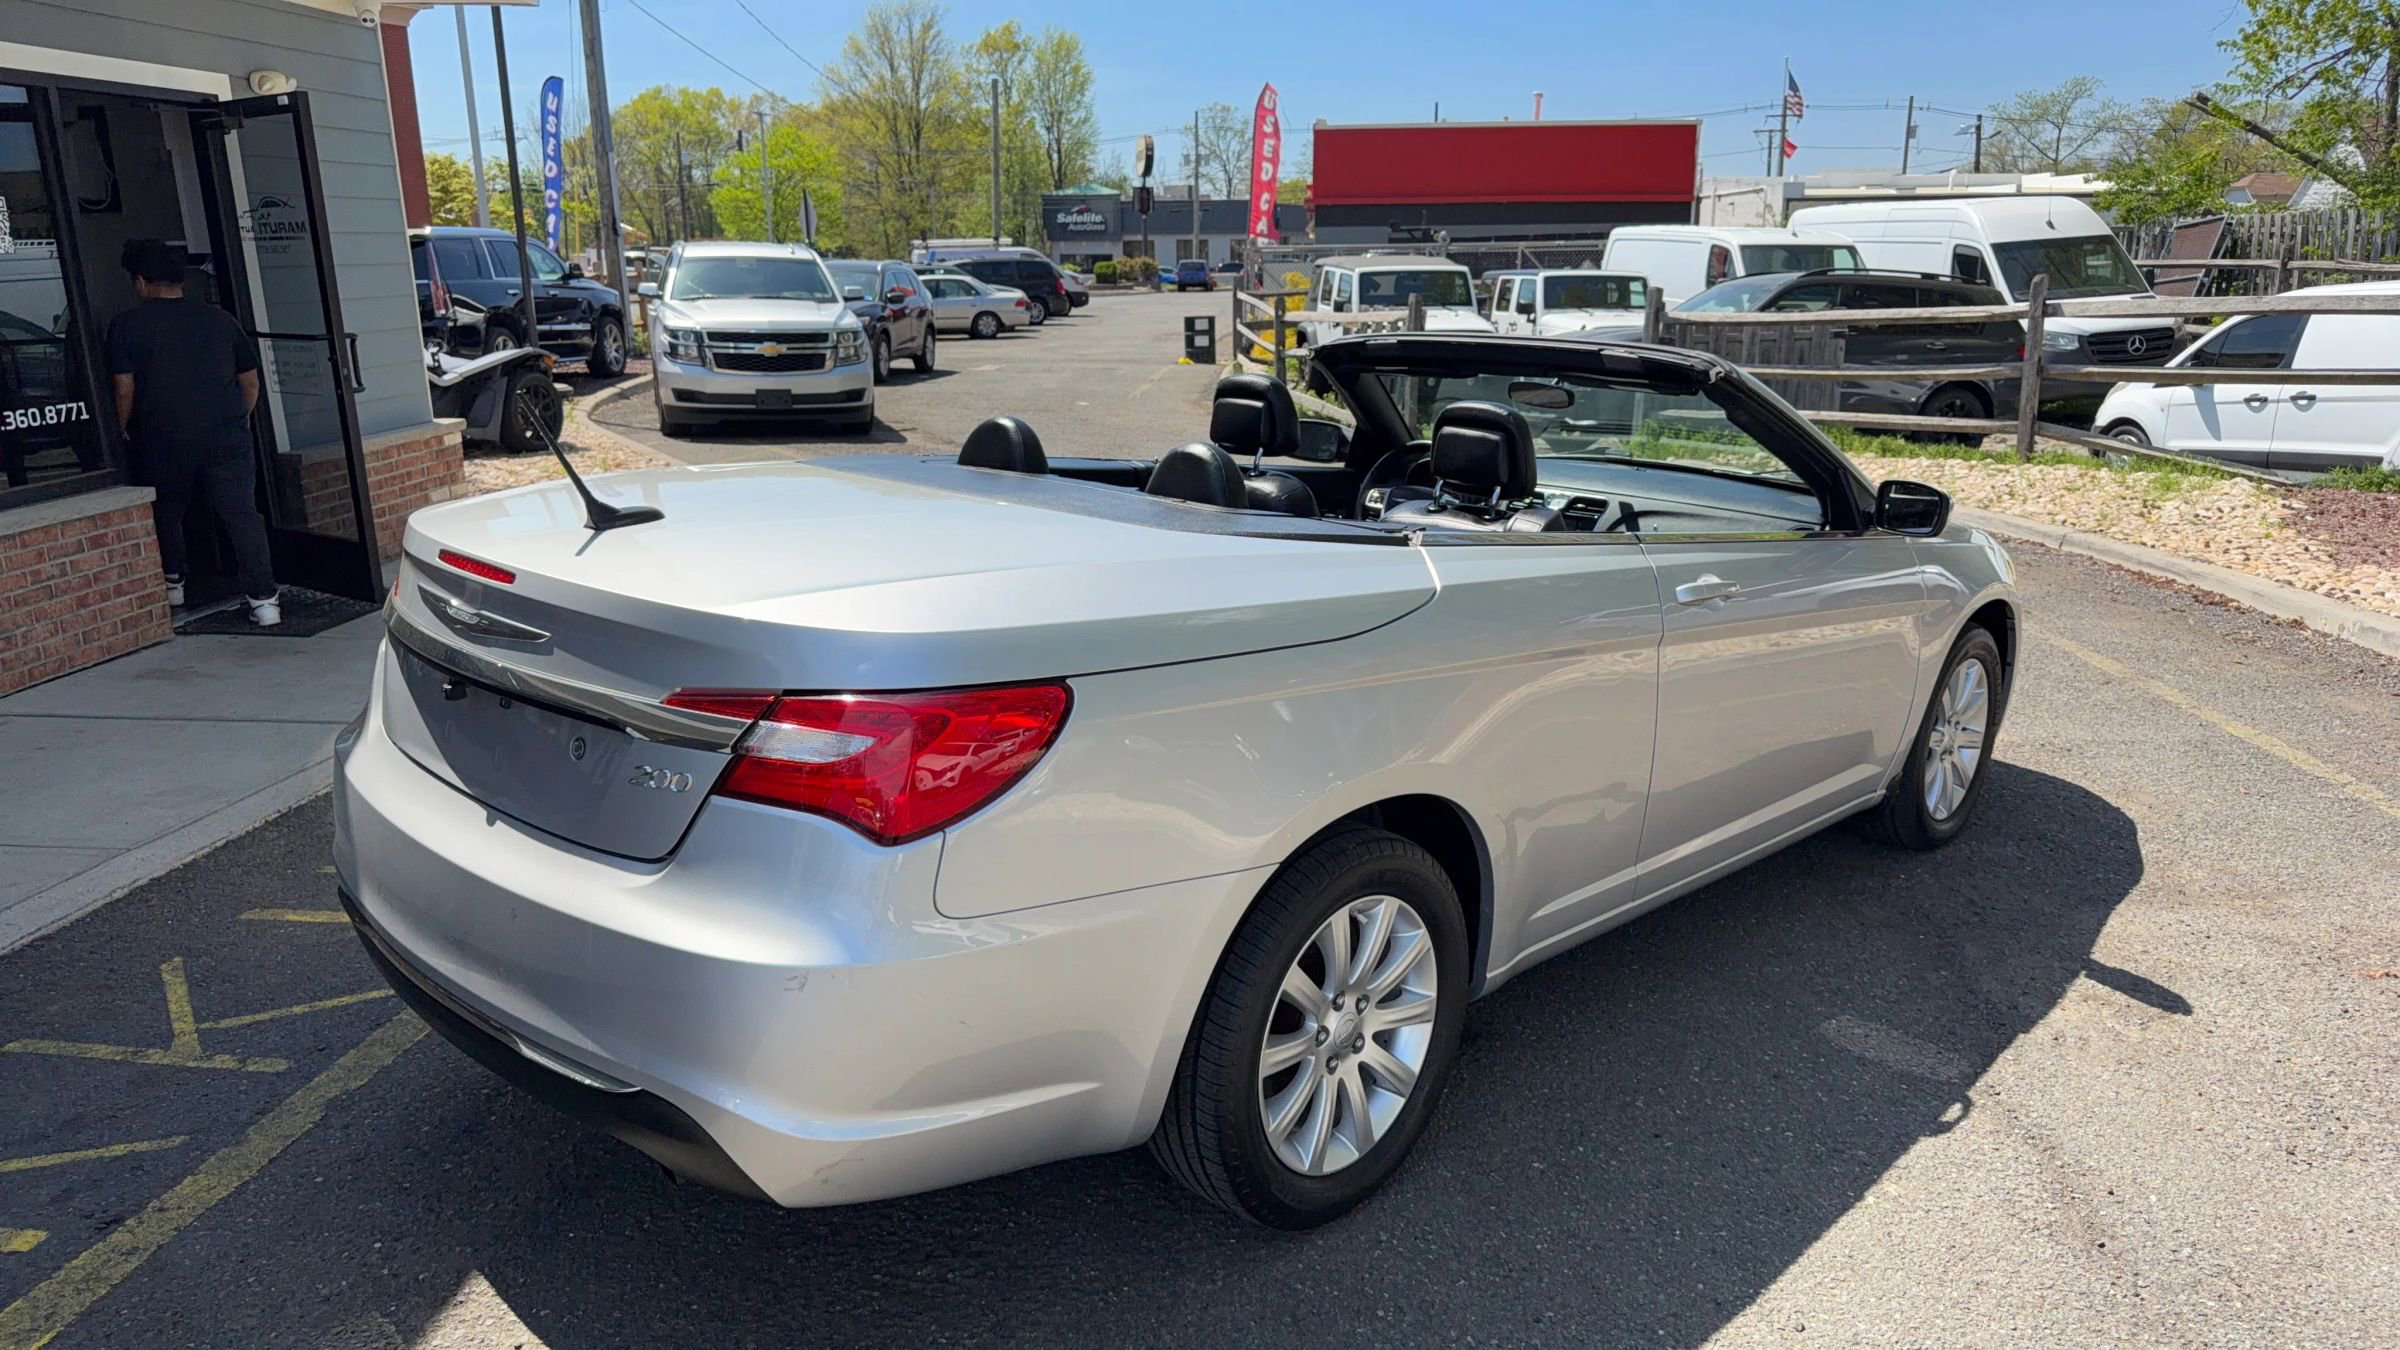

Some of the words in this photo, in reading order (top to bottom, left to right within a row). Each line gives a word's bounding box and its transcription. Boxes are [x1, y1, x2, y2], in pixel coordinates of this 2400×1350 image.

[546, 92, 558, 178] USED
[1260, 90, 1277, 181] USED
[628, 765, 694, 792] 200
